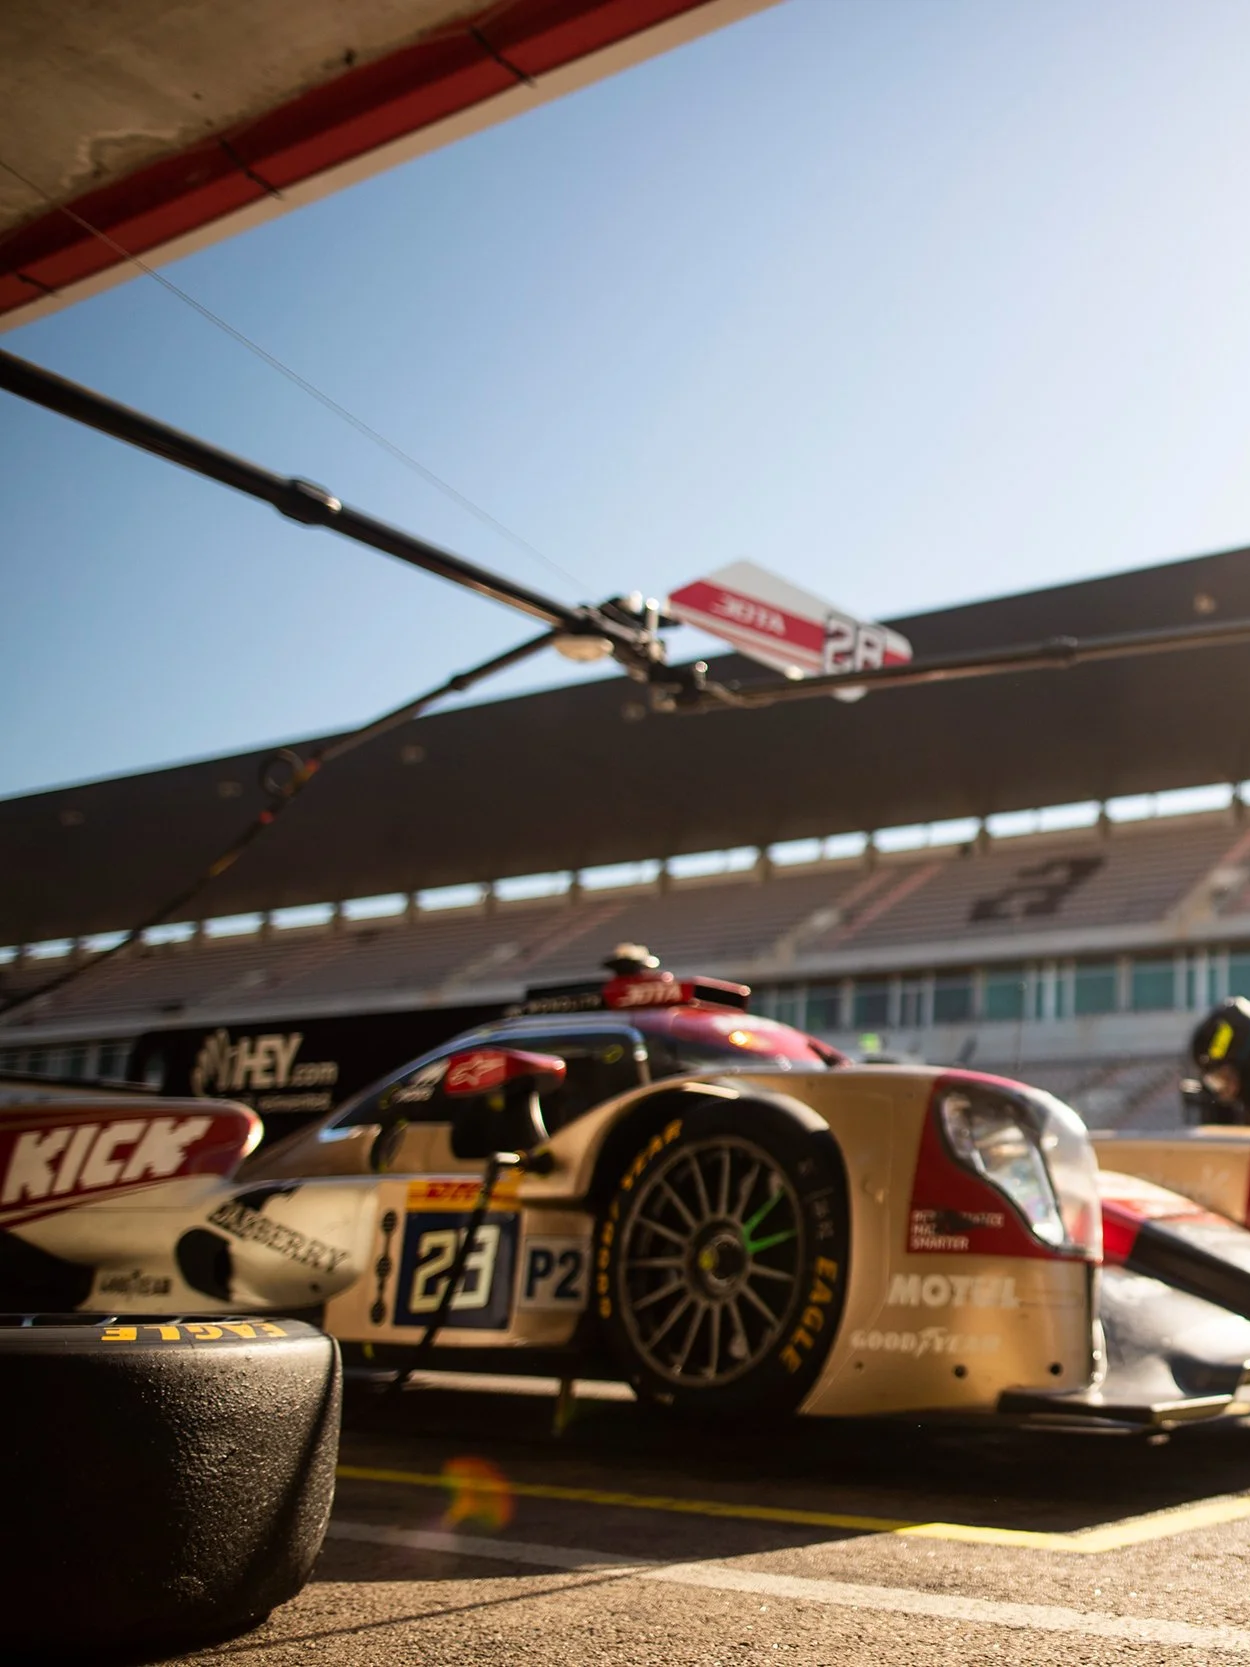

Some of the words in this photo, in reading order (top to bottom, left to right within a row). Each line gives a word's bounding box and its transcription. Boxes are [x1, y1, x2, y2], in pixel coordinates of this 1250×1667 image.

[2, 1115, 214, 1206] KICK
[911, 1236, 970, 1250] SMARTER
[523, 1248, 584, 1299] P2
[100, 1321, 289, 1342] EAGLE
[779, 1256, 839, 1374] EAGLE
